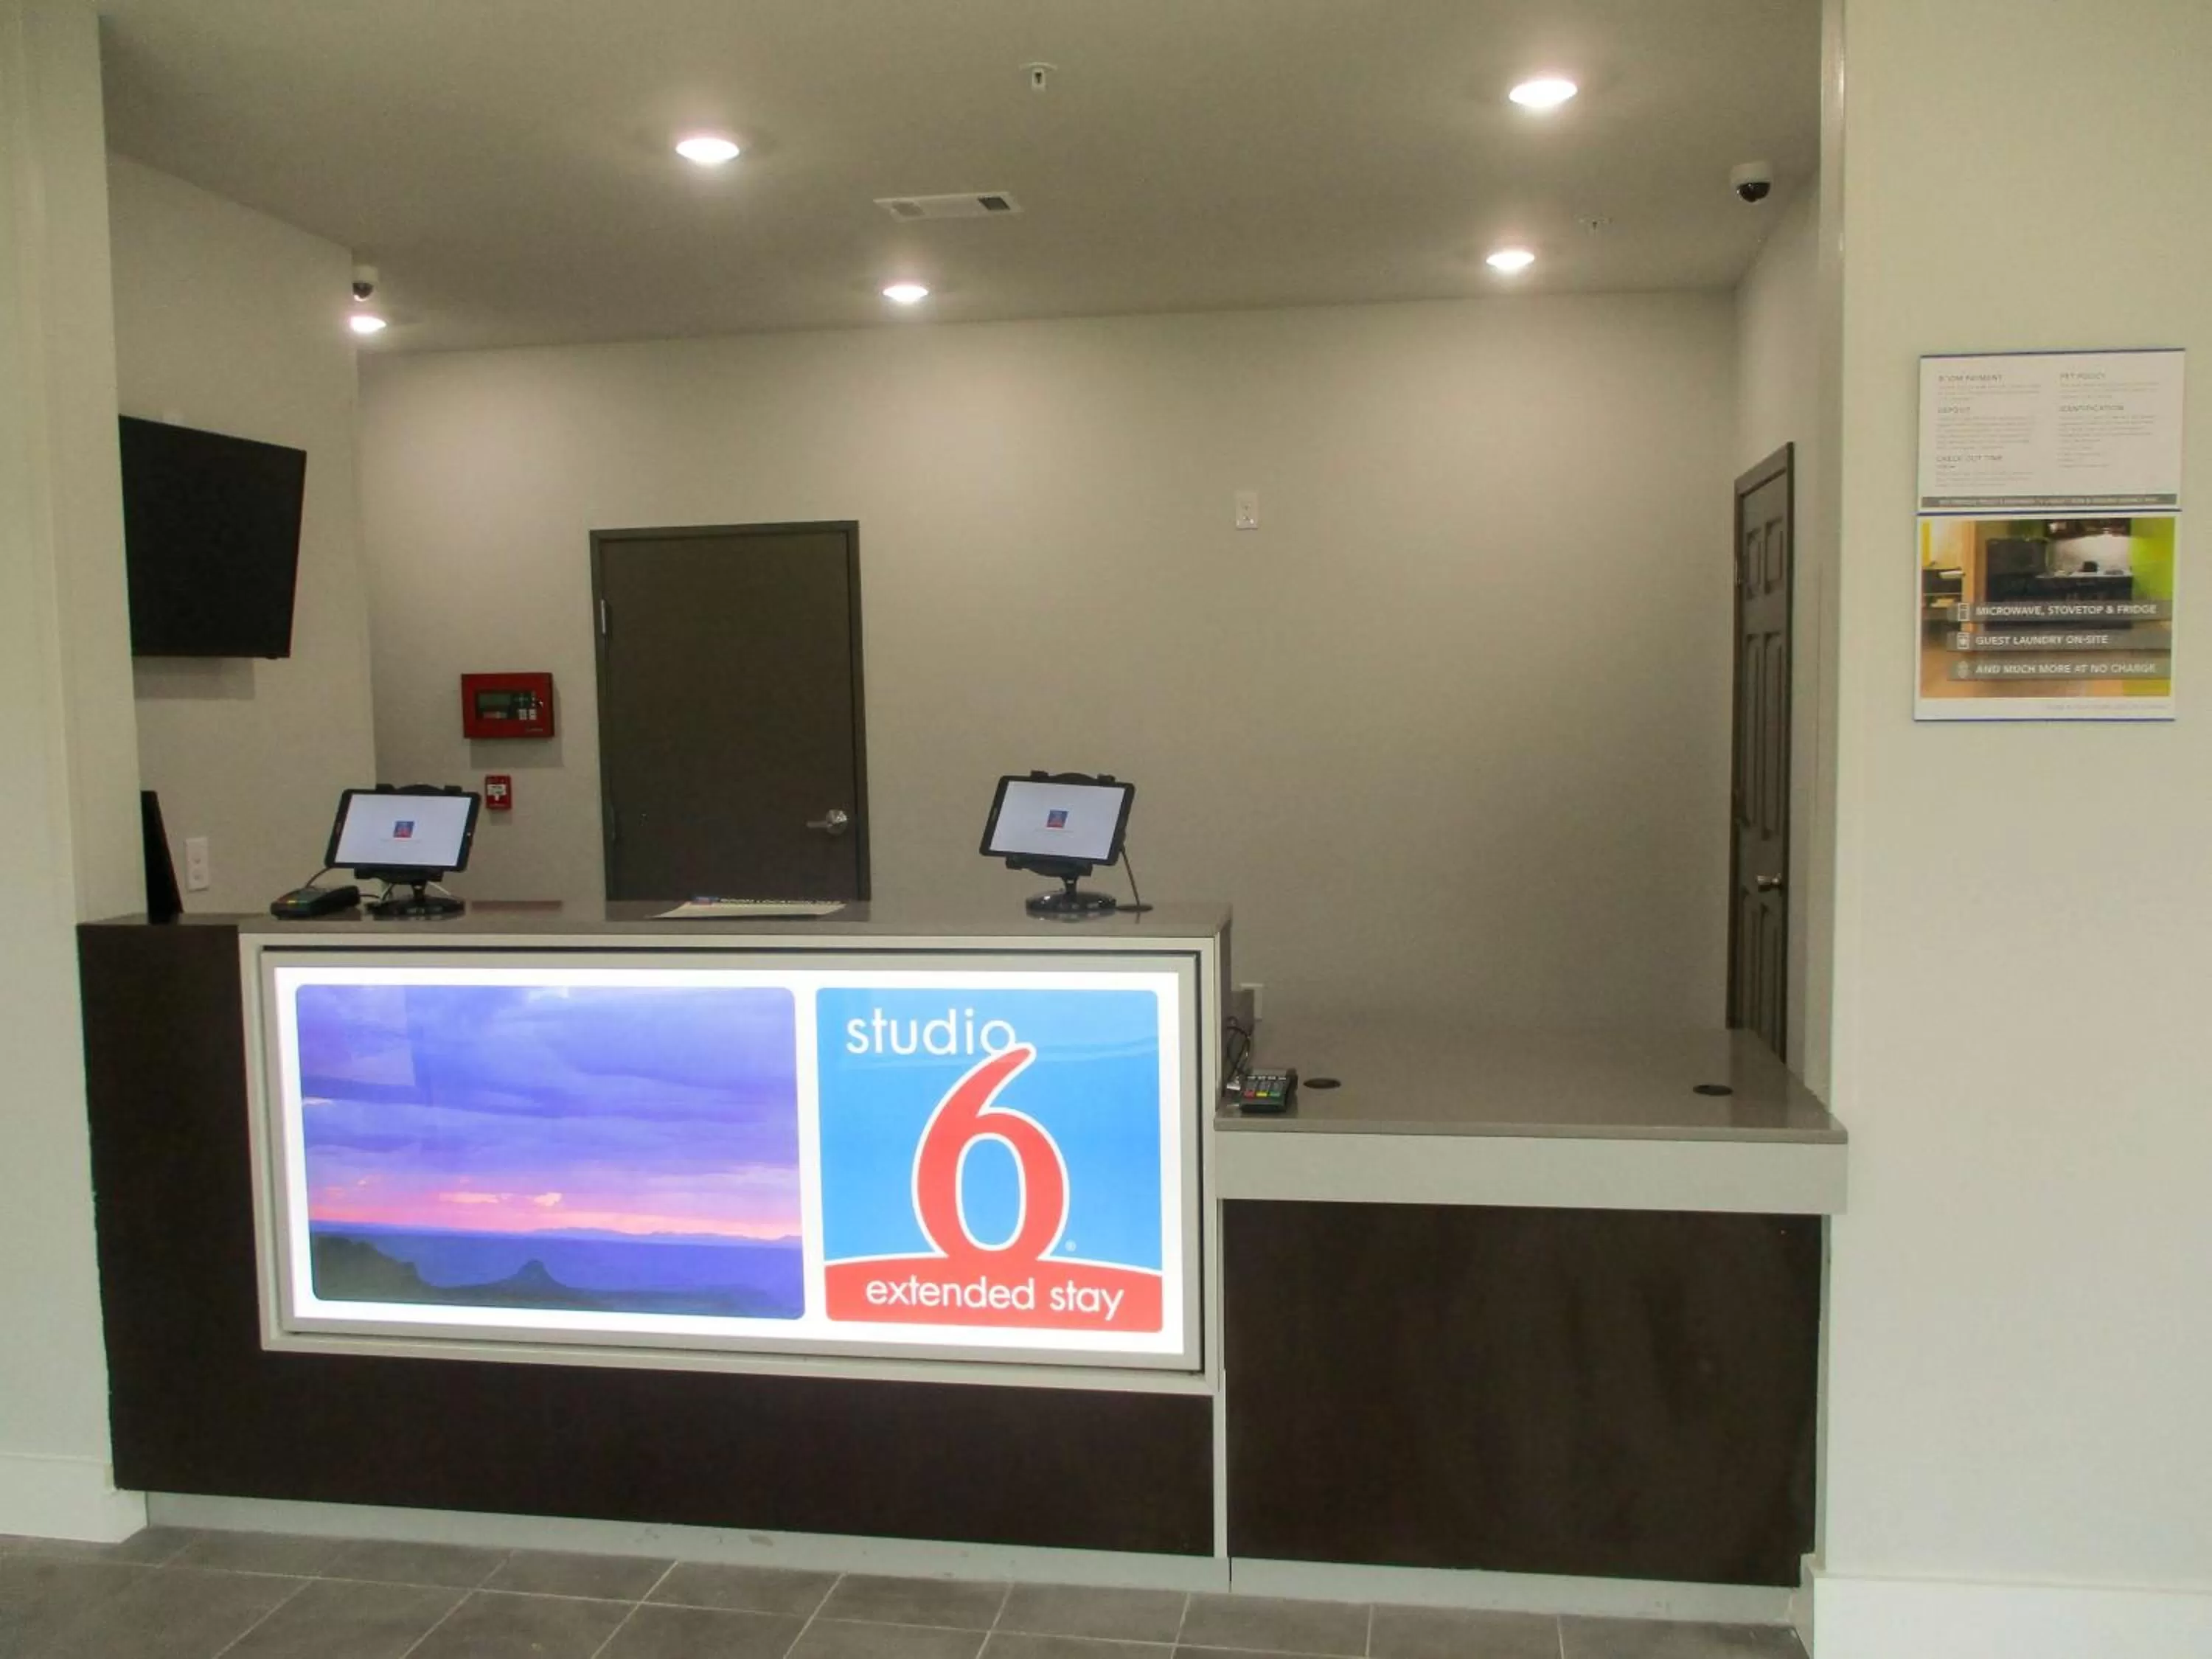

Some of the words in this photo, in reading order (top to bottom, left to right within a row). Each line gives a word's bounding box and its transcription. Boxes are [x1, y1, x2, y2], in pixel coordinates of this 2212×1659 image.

[1975, 605, 2045, 616] MICROWAVE,
[2048, 605, 2104, 615] STOVETOP
[2105, 605, 2114, 614] &
[2117, 605, 2157, 614] FRIDGE
[1975, 636, 2010, 645] GUEST
[2014, 636, 2062, 645] LAUNDRY
[2066, 635, 2110, 644] ON-SITE
[1975, 664, 2000, 674] AND
[2003, 664, 2035, 673] MUCH
[2039, 664, 2071, 673] MORE
[2090, 664, 2107, 673] NO
[2110, 664, 2156, 673] CHARGE
[846, 1007, 1017, 1056] studio
[911, 1041, 1071, 1260] 6
[865, 1275, 1035, 1310] extended
[1048, 1278, 1125, 1322] stay
